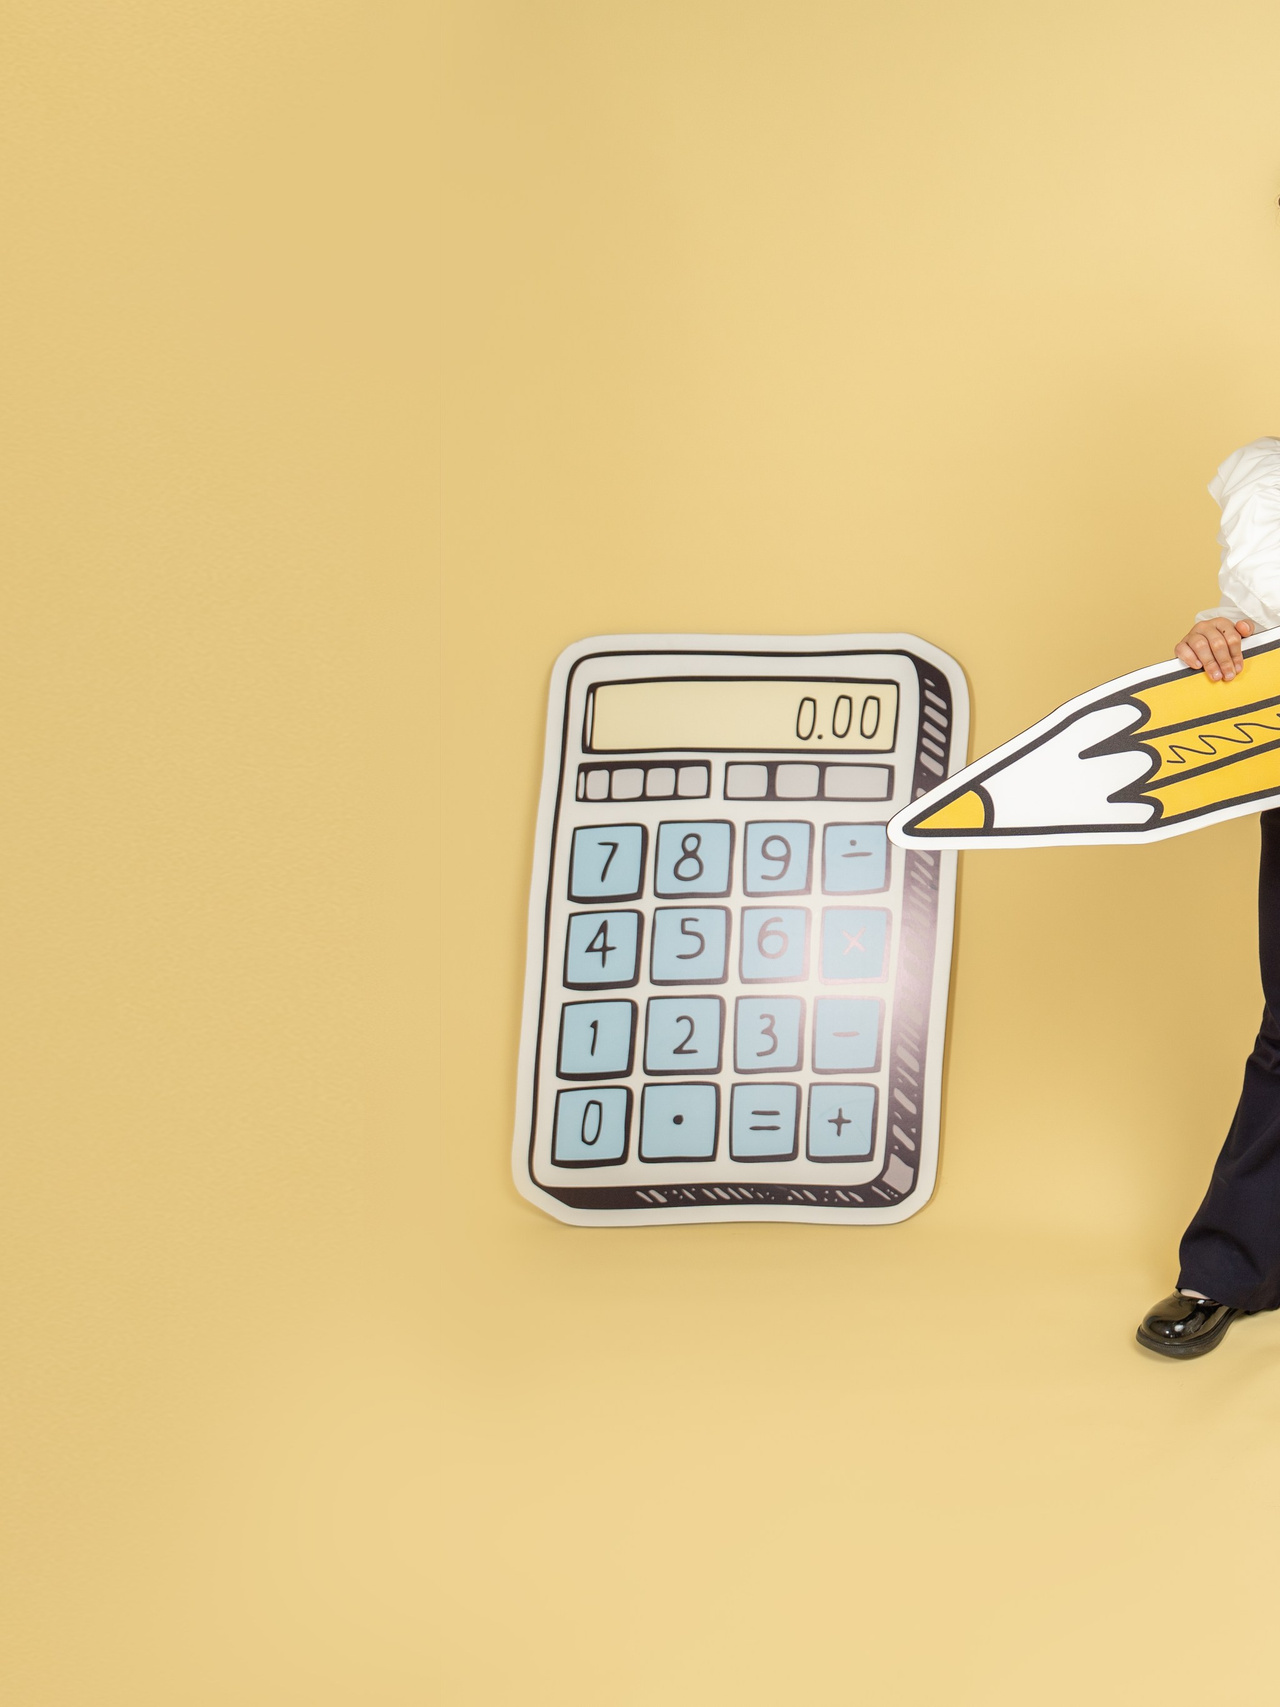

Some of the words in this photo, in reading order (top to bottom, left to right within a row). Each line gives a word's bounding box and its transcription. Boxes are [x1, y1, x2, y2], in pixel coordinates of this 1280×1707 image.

[795, 694, 881, 741] 0.00
[597, 841, 619, 883] 7
[673, 832, 704, 882] 8
[760, 834, 792, 881] 9
[584, 919, 617, 969] 4
[675, 917, 706, 960] 5
[757, 916, 788, 959] 6
[589, 1019, 599, 1057] 1
[672, 1015, 699, 1055] 2
[755, 1013, 779, 1058] 3
[580, 1099, 603, 1146] 0
